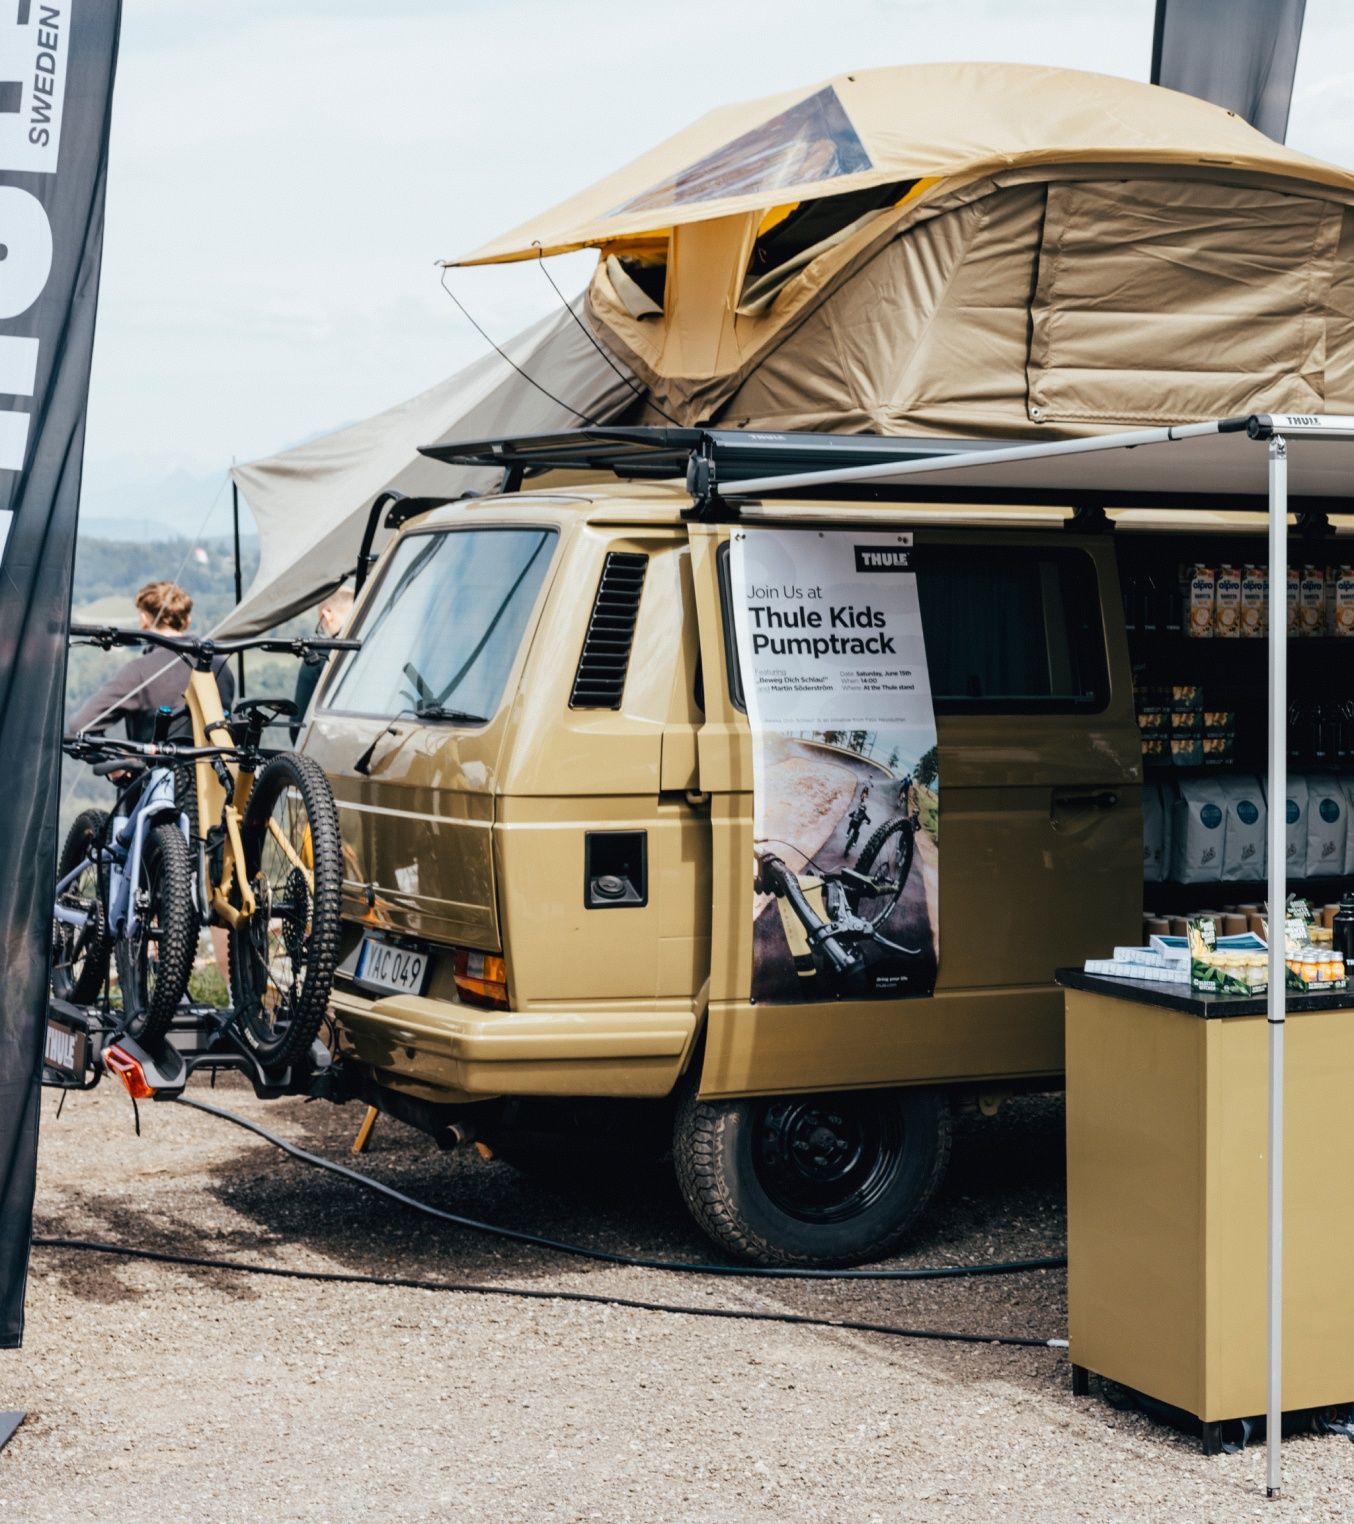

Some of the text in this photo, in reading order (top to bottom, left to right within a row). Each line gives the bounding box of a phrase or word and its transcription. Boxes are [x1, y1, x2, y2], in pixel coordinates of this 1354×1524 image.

[28, 5, 61, 148] SWEDEN
[861, 552, 908, 566] THULE
[747, 585, 822, 599] Join Us at
[1193, 580, 1214, 591] alpro
[1218, 580, 1240, 591] alpro
[1243, 580, 1262, 591] alpro
[748, 605, 886, 628] Thule Kids
[752, 632, 896, 659] Pumptrack
[793, 684, 834, 692] Söderström
[367, 944, 421, 988] YAC 049
